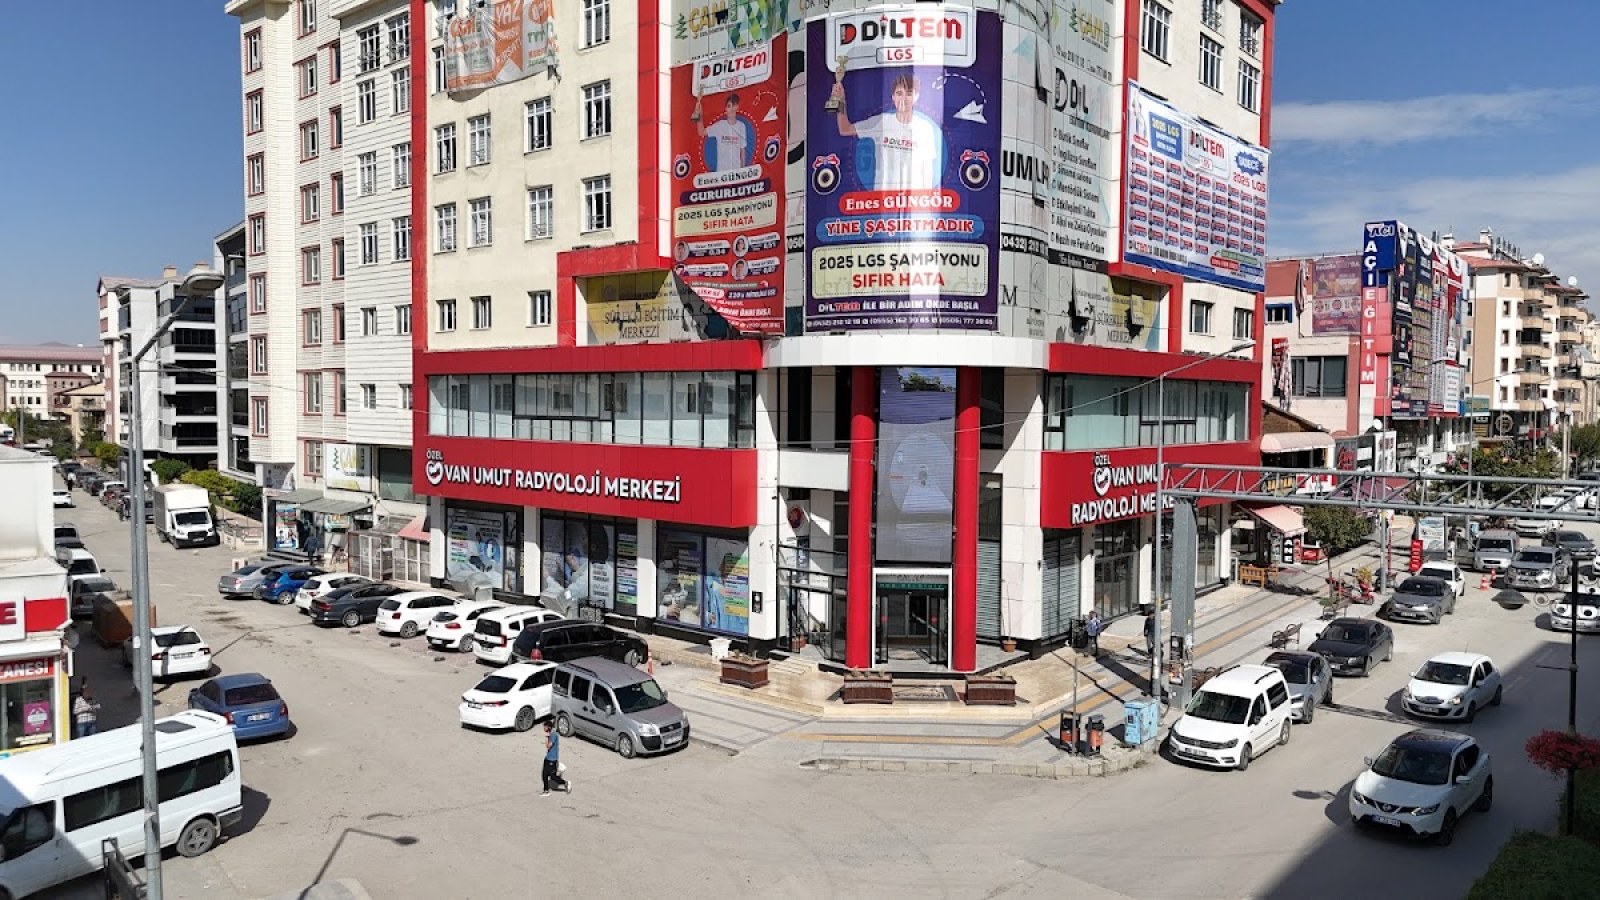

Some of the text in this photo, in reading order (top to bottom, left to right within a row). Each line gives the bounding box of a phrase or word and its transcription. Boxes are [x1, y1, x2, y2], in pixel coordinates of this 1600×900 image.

[887, 48, 913, 61] LGS
[689, 181, 765, 202] GURURLUYUZ
[846, 191, 953, 211] Enes GÜNGÖR
[678, 198, 773, 221] 2025 LGS ŞAMPİYONU
[703, 215, 754, 230] SIFIR HATA
[826, 218, 974, 238] YİNE ŞAŞIRTMADIK
[819, 249, 980, 271] 2025 LGS ŞAMPİYONU
[852, 271, 945, 289] SIFIR HATA
[863, 300, 877, 310] İLE
[879, 299, 896, 310] BİR
[897, 299, 924, 309] ADIM
[951, 301, 980, 312] BAŞLA
[426, 448, 443, 460] ÖZEL
[1094, 451, 1112, 466] ÖZEL
[444, 463, 682, 503] VAN UMUT RADYOLOJİ MERKEZİ
[1111, 464, 1135, 487] VAN
[1071, 489, 1138, 525] RADYOLOJİ
